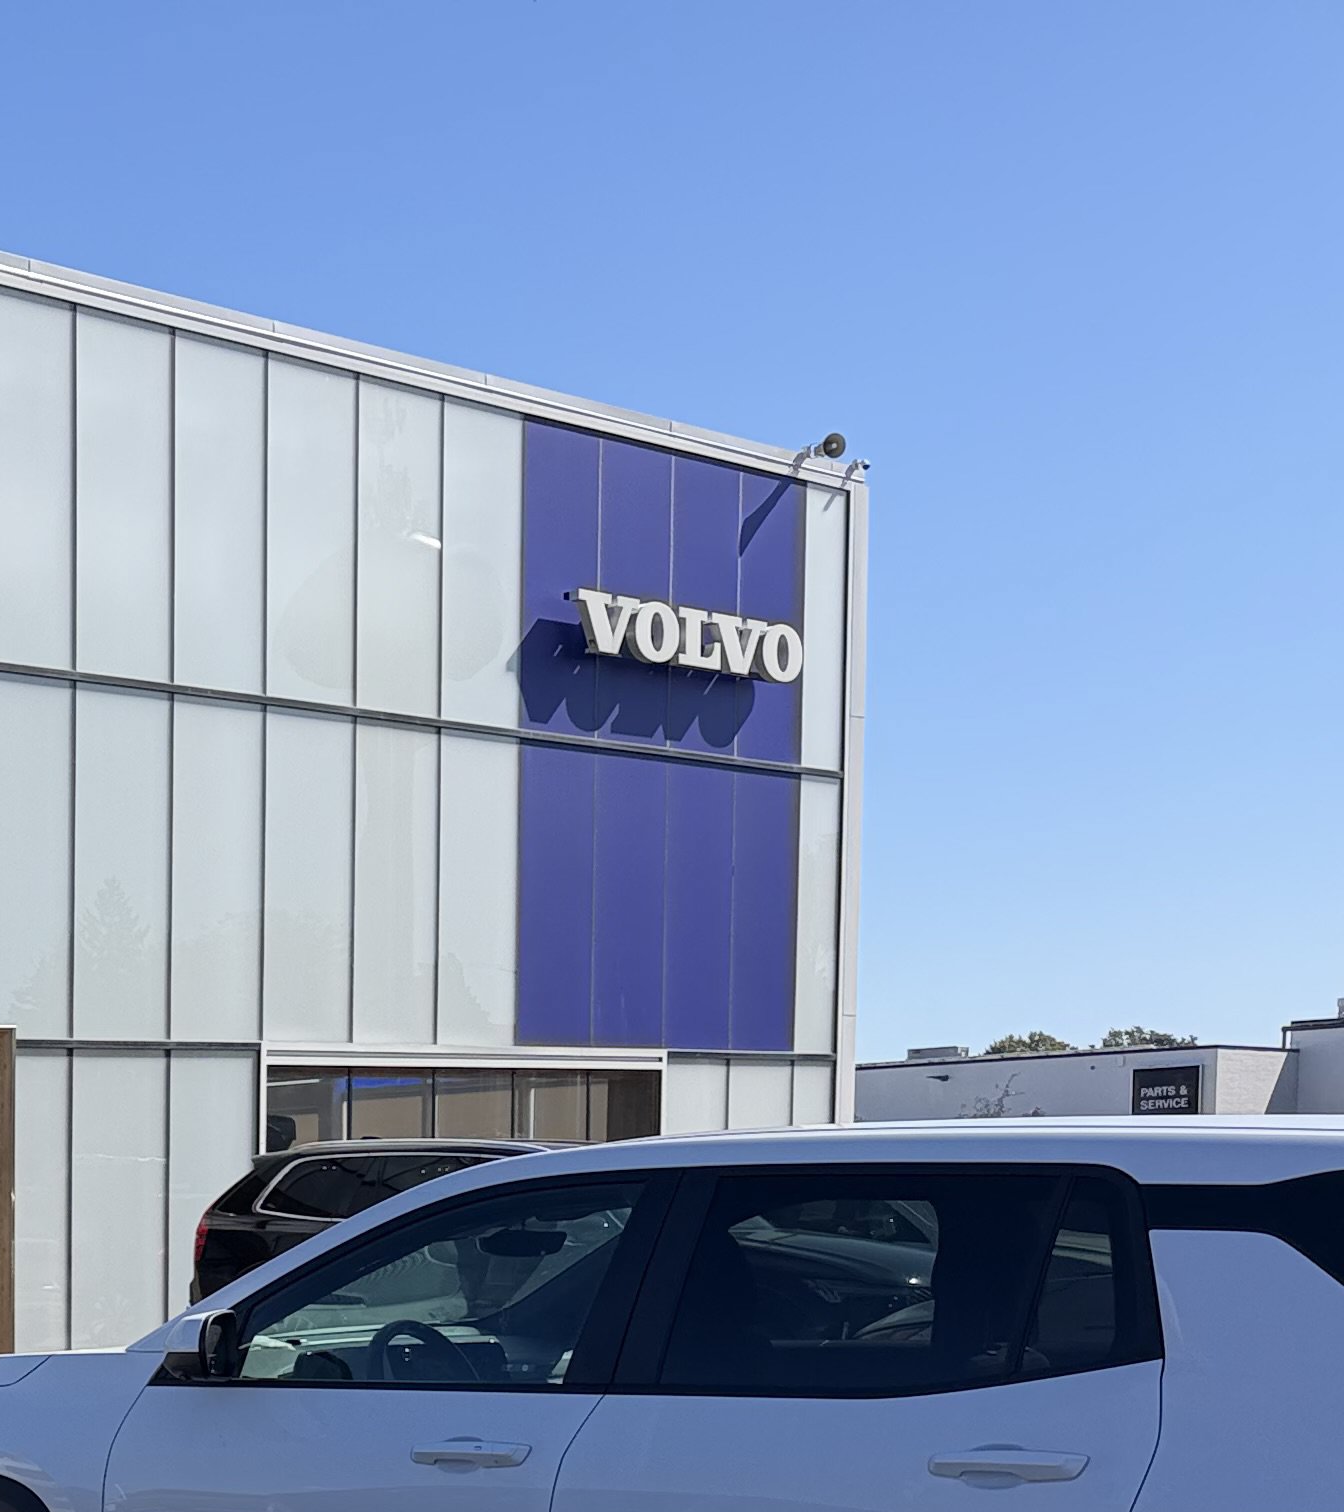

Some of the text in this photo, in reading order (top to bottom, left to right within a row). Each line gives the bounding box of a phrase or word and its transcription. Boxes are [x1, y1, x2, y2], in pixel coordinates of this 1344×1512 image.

[576, 588, 804, 683] VOLVO
[1140, 1085, 1188, 1098] PARTS &
[1140, 1098, 1189, 1111] SERVICE
